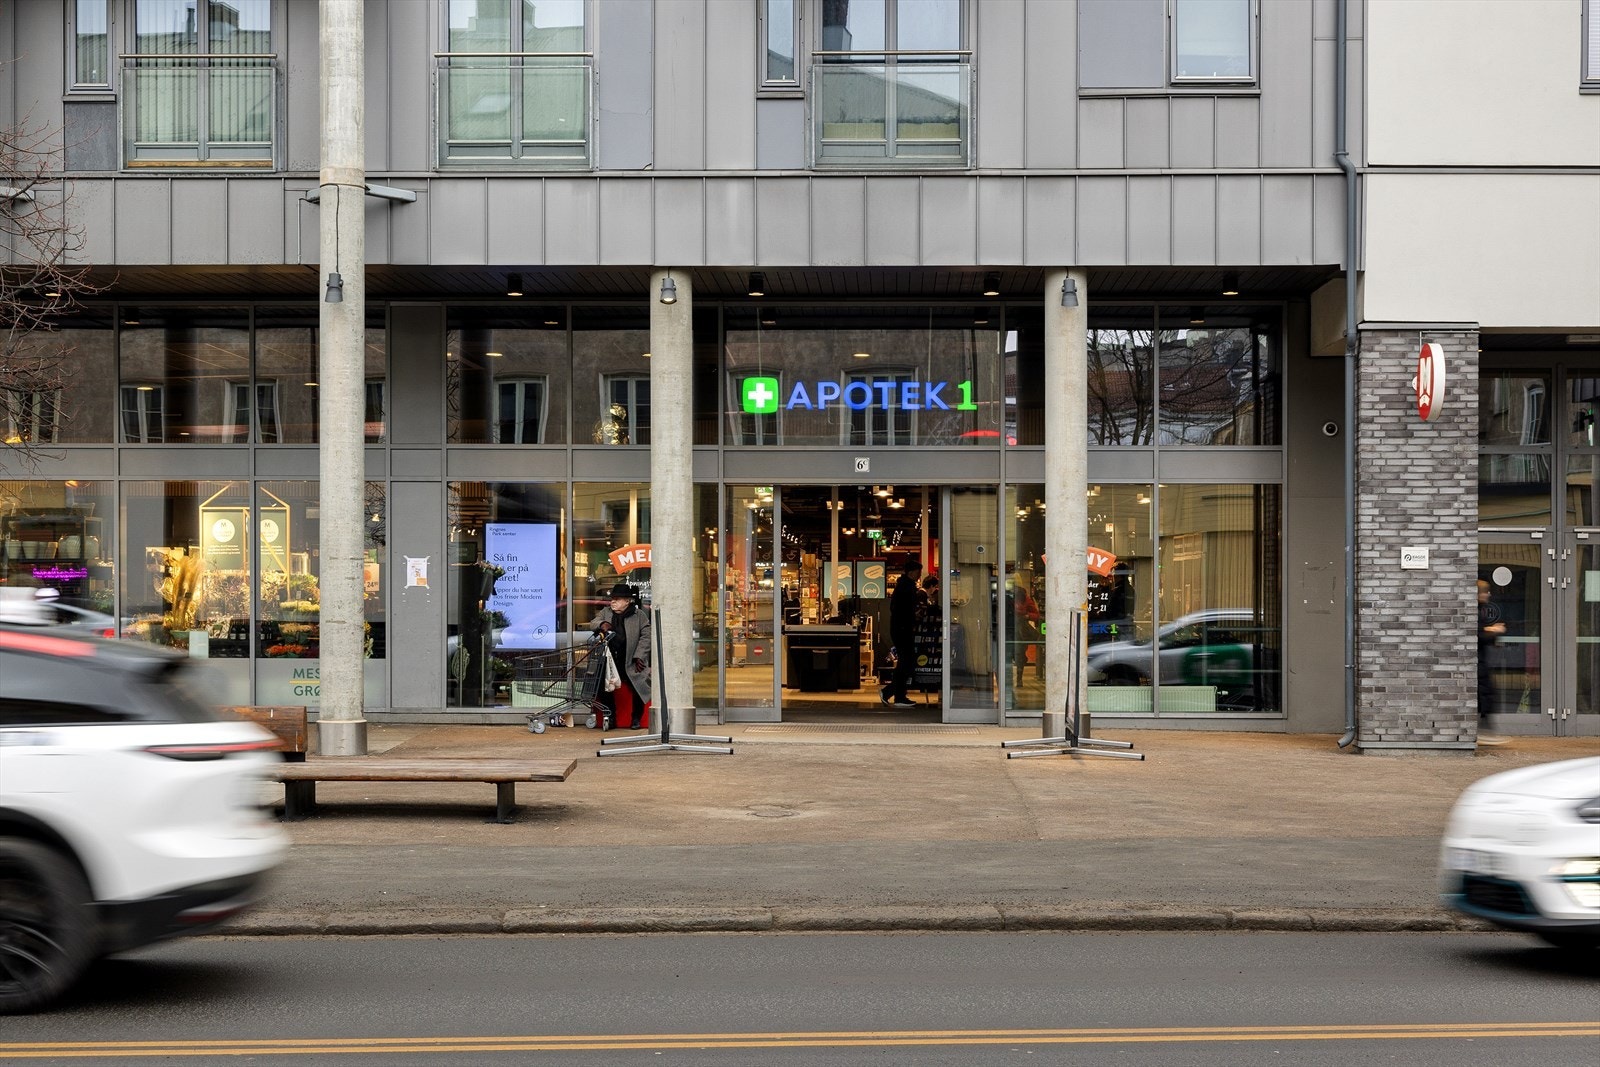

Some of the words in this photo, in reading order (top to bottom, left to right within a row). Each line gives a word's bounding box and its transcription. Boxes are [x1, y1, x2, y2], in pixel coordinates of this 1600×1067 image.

[785, 381, 950, 411] APOTEK
[956, 380, 978, 411] 1
[494, 554, 504, 562] Så
[506, 554, 518, 562] fin
[618, 550, 652, 566] ME
[518, 564, 528, 573] på
[1110, 624, 1118, 634] 1
